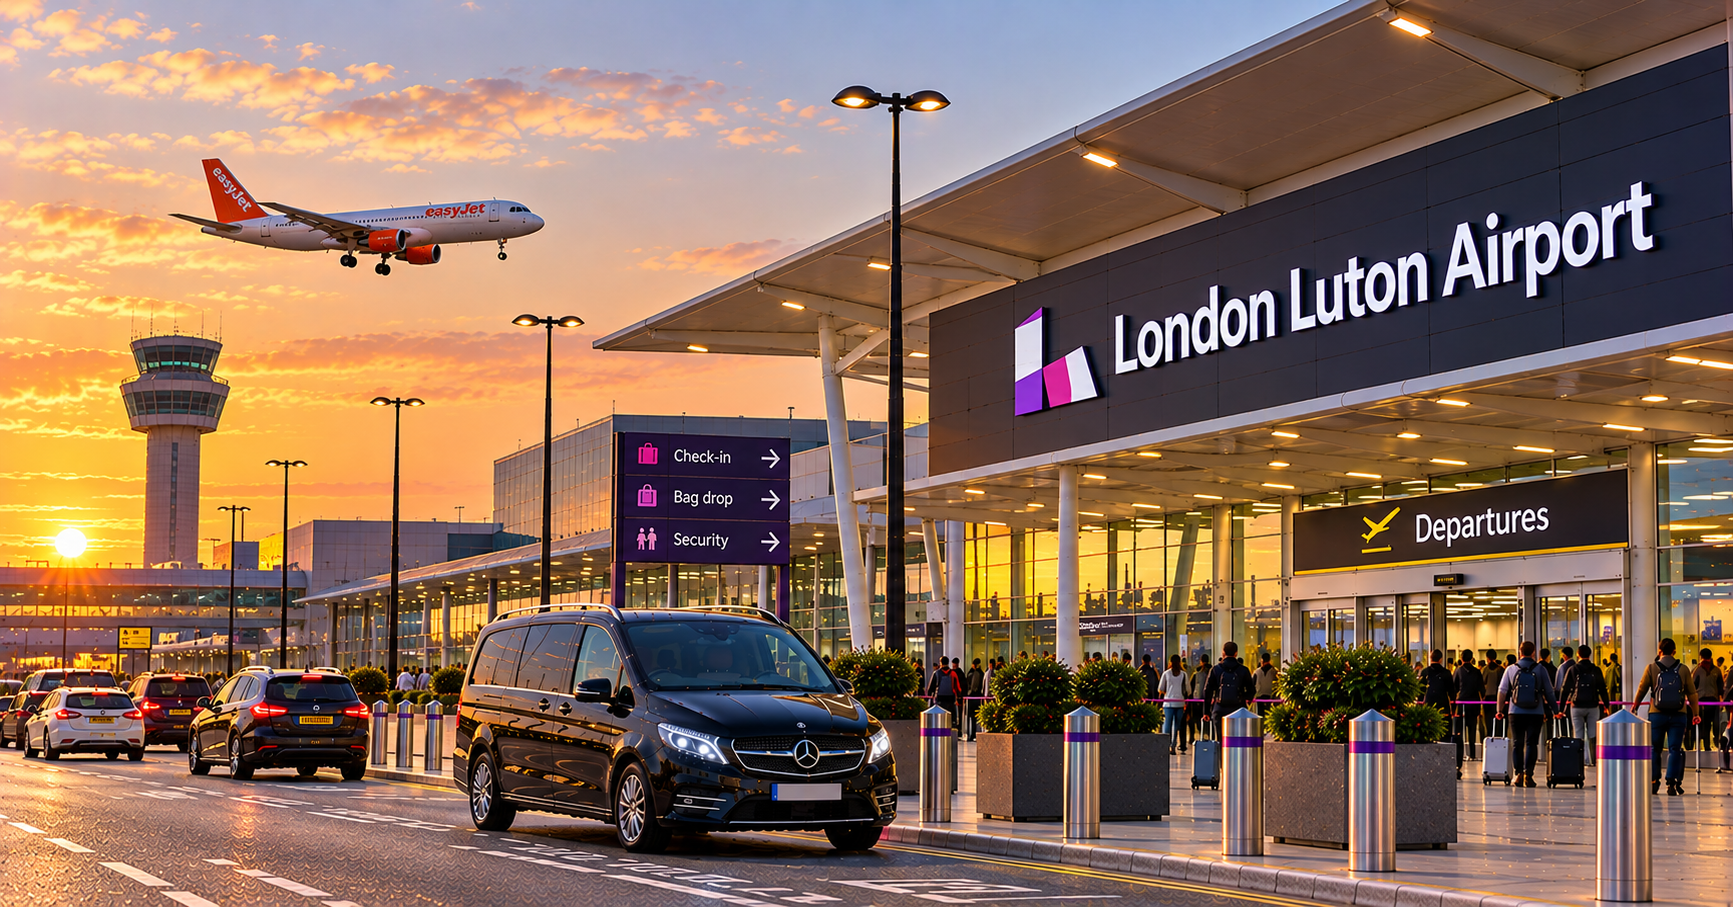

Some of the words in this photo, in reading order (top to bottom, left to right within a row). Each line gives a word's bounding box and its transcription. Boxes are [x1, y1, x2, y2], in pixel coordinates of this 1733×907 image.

[212, 167, 252, 213] easyJet
[425, 203, 486, 219] easyJet
[1115, 284, 1276, 375] London
[1290, 252, 1428, 332] Luton
[1441, 181, 1655, 298] Airport
[673, 448, 731, 464] Check-in
[673, 489, 699, 508] Bag
[702, 490, 733, 508] drop
[1415, 505, 1549, 547] Departures
[673, 532, 729, 550] Security
